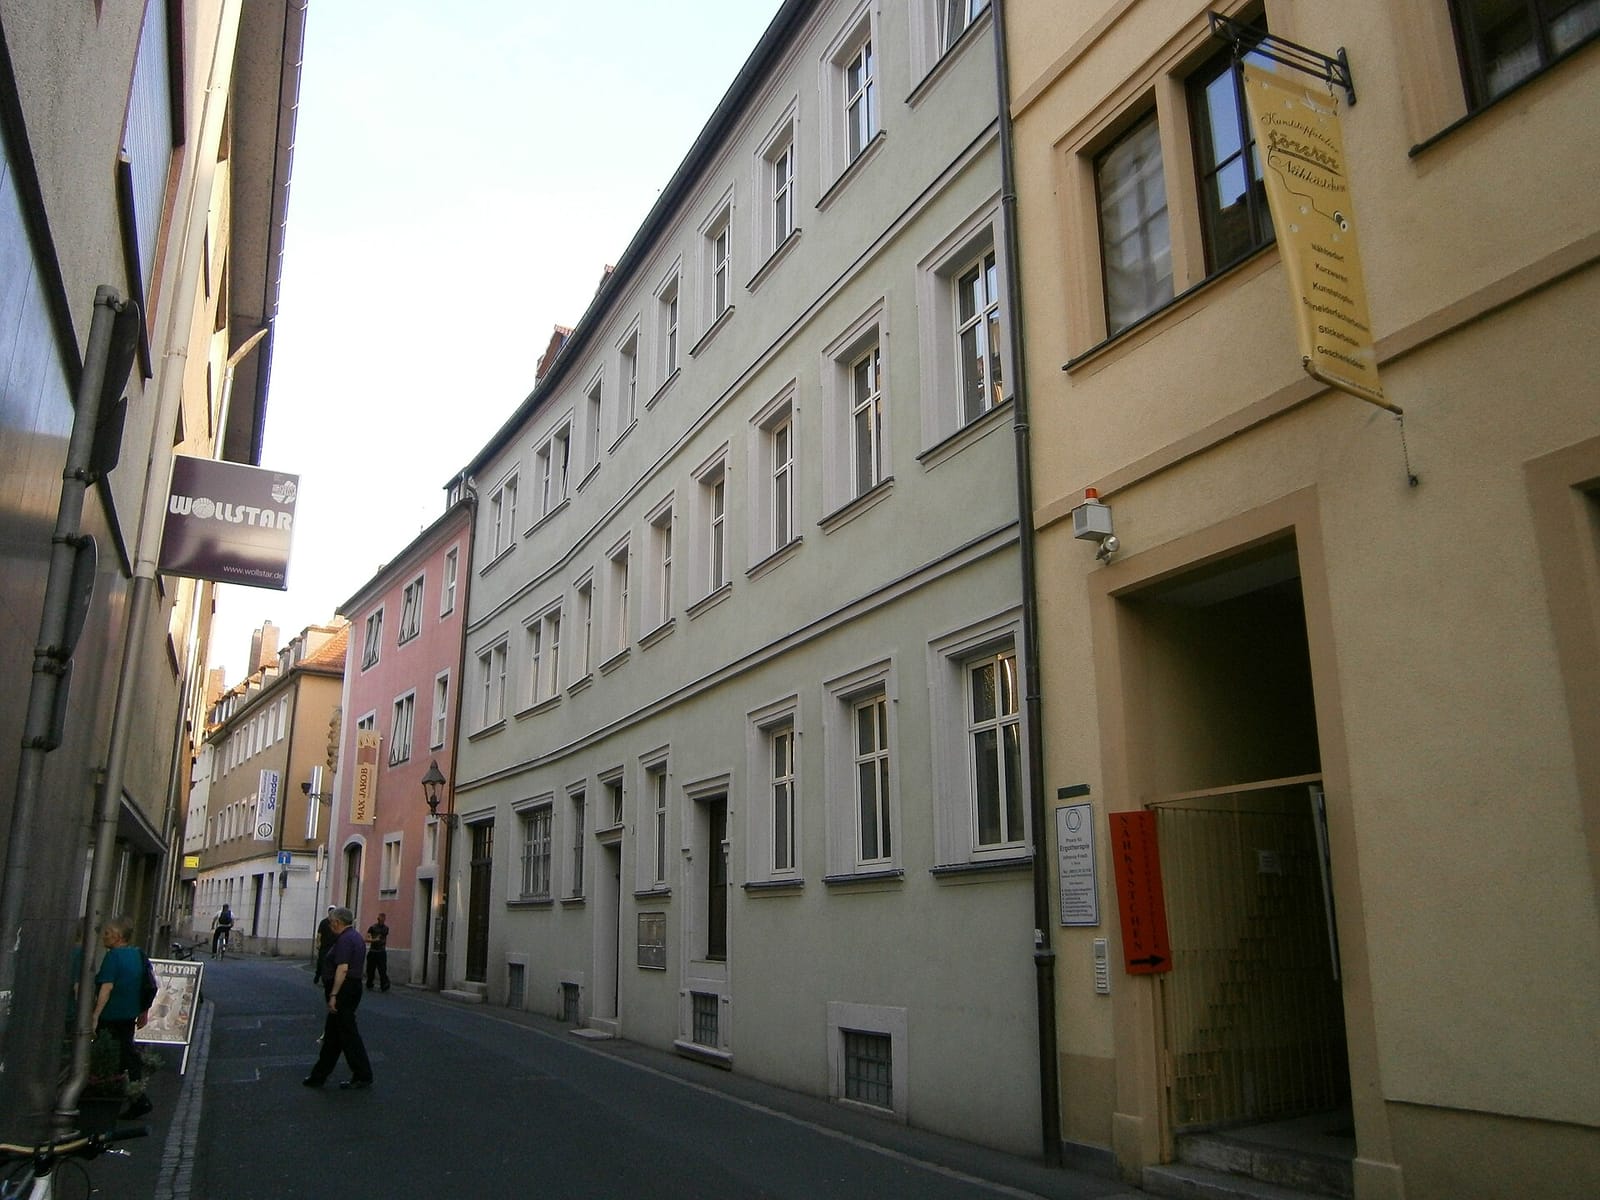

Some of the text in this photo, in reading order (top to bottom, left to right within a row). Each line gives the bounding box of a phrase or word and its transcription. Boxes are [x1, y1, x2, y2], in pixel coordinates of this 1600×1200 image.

[169, 494, 293, 529] WOLLSTAR
[223, 565, 284, 579] www.wollstar.de
[357, 767, 369, 820] MAX JAKOB
